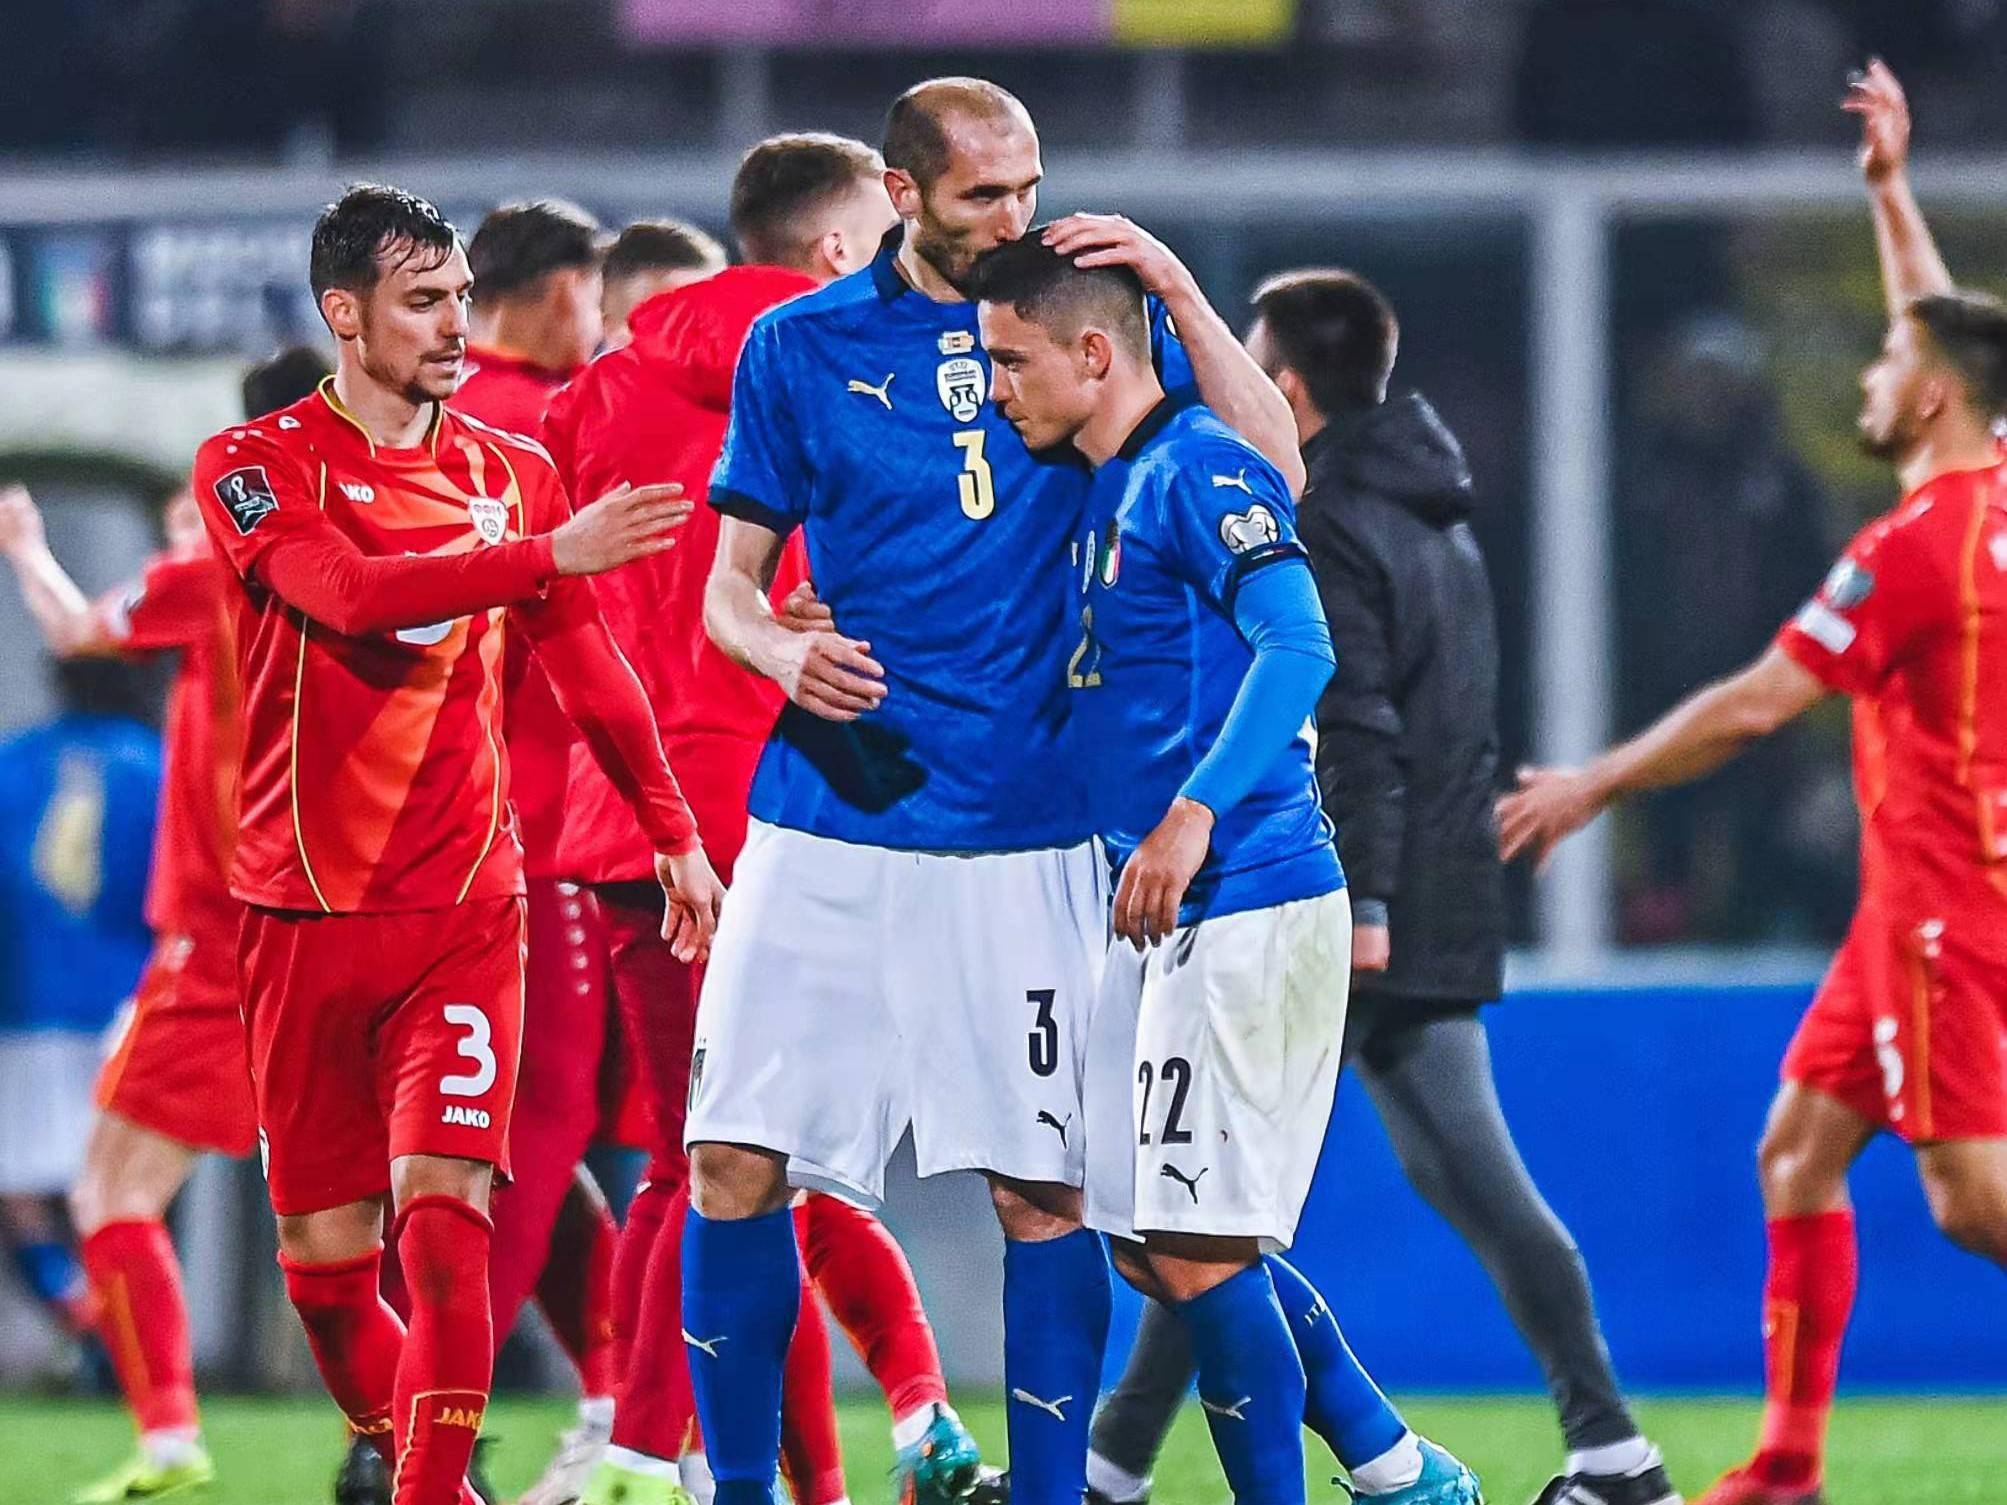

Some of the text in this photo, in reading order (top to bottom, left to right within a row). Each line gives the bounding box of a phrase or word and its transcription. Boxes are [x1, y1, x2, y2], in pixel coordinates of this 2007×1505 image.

[952, 428, 996, 521] 3
[440, 1004, 497, 1098] 3
[1025, 988, 1059, 1078] 3
[441, 1106, 491, 1129] JAKO
[1138, 1057, 1194, 1146] 22
